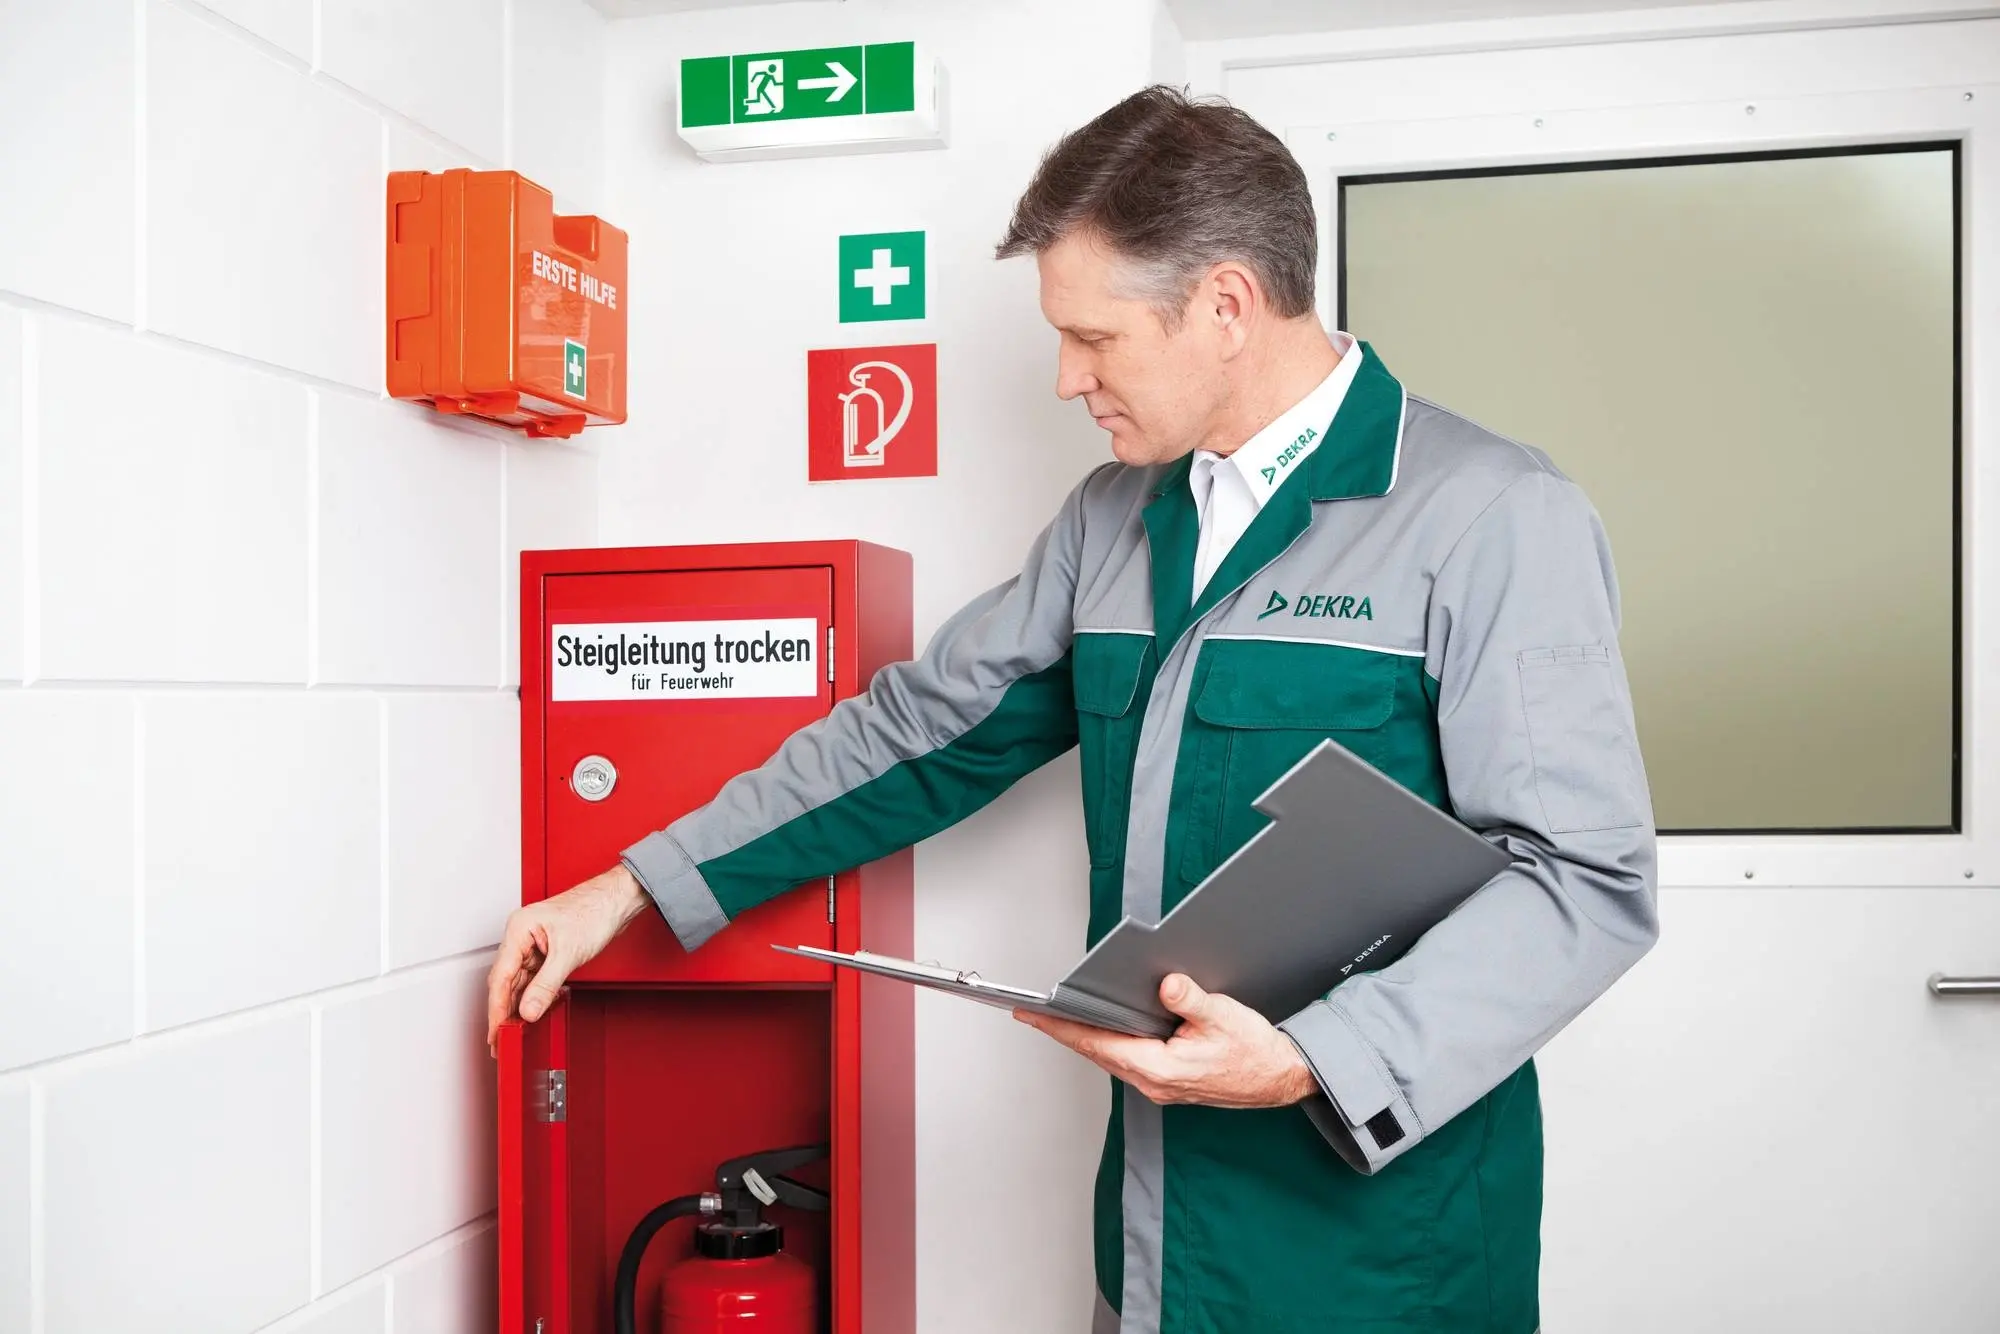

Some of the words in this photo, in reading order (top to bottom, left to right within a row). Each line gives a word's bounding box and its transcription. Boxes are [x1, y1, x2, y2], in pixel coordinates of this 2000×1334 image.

[532, 250, 577, 292] ERSTE
[580, 271, 617, 310] HILFE
[1276, 428, 1318, 468] DEKRA
[1293, 595, 1373, 620] DEKRA
[557, 633, 706, 675] Steigleitung
[714, 630, 811, 664] trocken
[631, 673, 651, 690] für
[660, 672, 734, 690] Feuerwehr
[1354, 934, 1392, 962] DEKRA
